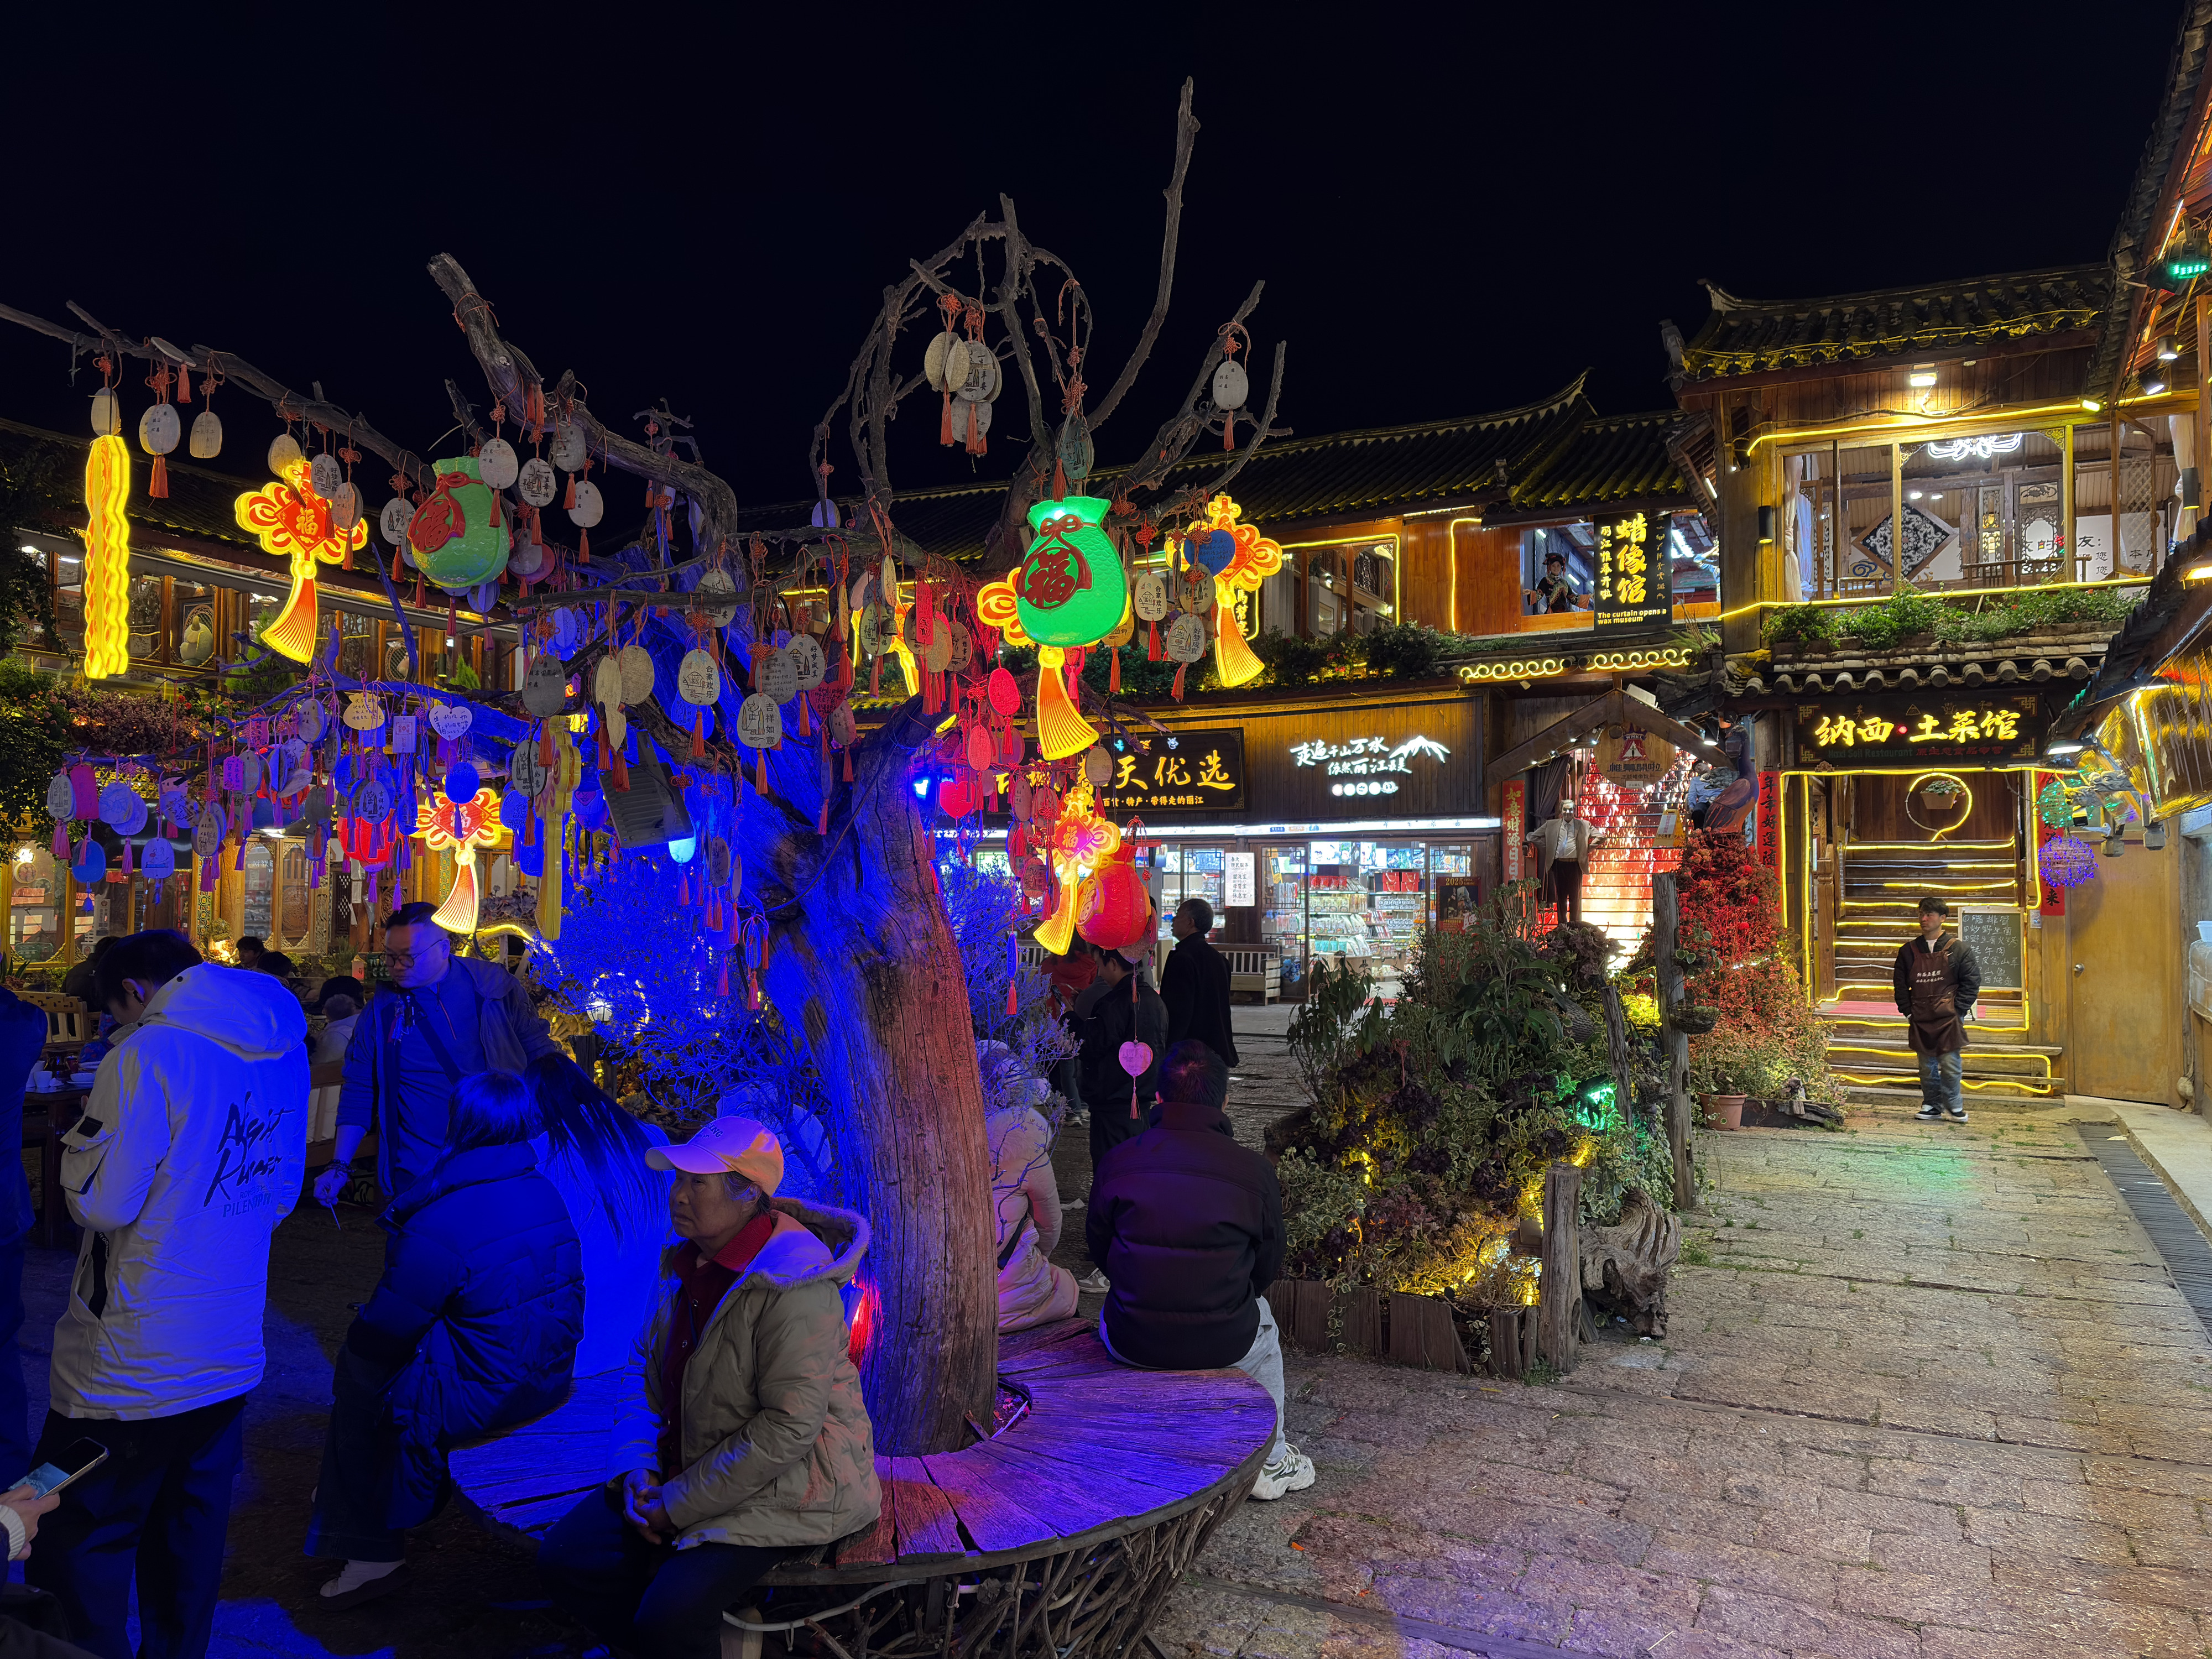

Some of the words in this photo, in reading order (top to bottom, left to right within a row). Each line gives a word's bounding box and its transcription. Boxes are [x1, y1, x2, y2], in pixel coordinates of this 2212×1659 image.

[296, 508, 319, 536] 福
[1600, 525, 1613, 601] 丽江帷幕开啦
[1616, 513, 1648, 604] 蜡像馆
[1024, 549, 1076, 607] 福
[1613, 610, 1638, 618] curtain
[1640, 609, 1661, 618] opens
[1190, 628, 1202, 655] 好梦成真
[810, 645, 818, 678] 好梦成真
[706, 665, 714, 698] 合家欢乐
[765, 703, 775, 745] 吉祥如意
[1290, 737, 1390, 767] 走遍千山万水
[1865, 748, 1913, 758] Restaurant
[1062, 826, 1078, 848] 福
[1505, 787, 1521, 880] 如意財源日日
[1760, 775, 1780, 881] 年年好運随
[1446, 878, 1464, 886] 2025
